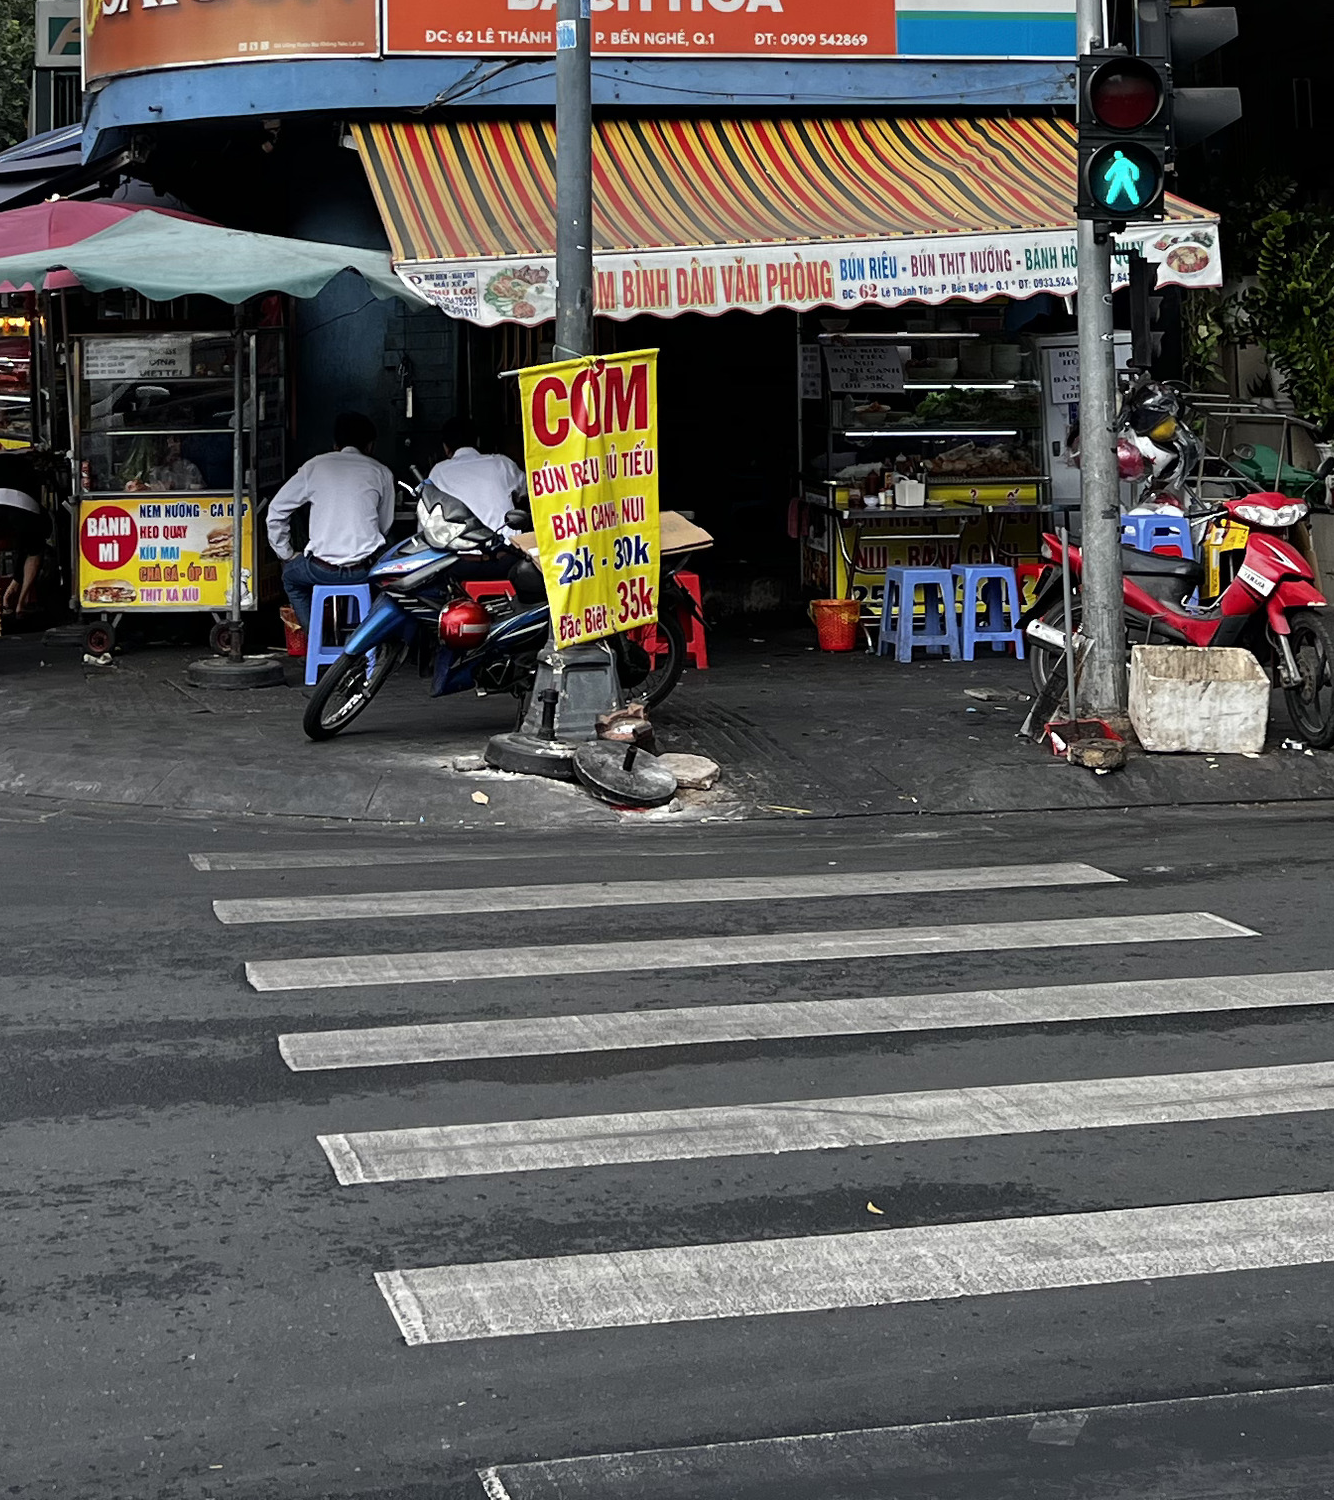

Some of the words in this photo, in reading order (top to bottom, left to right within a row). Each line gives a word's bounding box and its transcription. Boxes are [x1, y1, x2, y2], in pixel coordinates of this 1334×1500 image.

[425, 29, 453, 44] ĐC:
[455, 30, 473, 43] 62
[477, 26, 495, 44] LÊ
[498, 27, 552, 44] THÁNH
[595, 31, 607, 45] P.
[611, 27, 640, 45] BẾN
[644, 28, 690, 47] NGHÉ,
[693, 32, 715, 46] Q.1
[754, 33, 777, 46] ĐT:
[780, 33, 816, 46] 0909
[819, 33, 868, 46] 542869
[839, 251, 865, 281] BÚN
[869, 251, 898, 279] RIÊU
[910, 248, 936, 278] BÚN
[970, 245, 1012, 274] NƯỚNG
[1024, 241, 1057, 271] BÁNH
[623, 259, 672, 309] BÌNH
[676, 256, 716, 307] DÂN
[720, 255, 762, 303] VĂN
[766, 252, 835, 301] PHÒNG
[859, 283, 879, 299] 62
[532, 358, 648, 447] CƠM
[532, 460, 568, 497] BÚN
[621, 440, 654, 477] TIẾU
[139, 504, 161, 518] NEM
[621, 496, 645, 524] NUI
[86, 514, 131, 537] BÁNH
[139, 525, 159, 539] HEO
[162, 525, 188, 539] QUAY
[98, 540, 120, 563] MÌ
[613, 535, 650, 570] 30k
[617, 576, 654, 623] 35k
